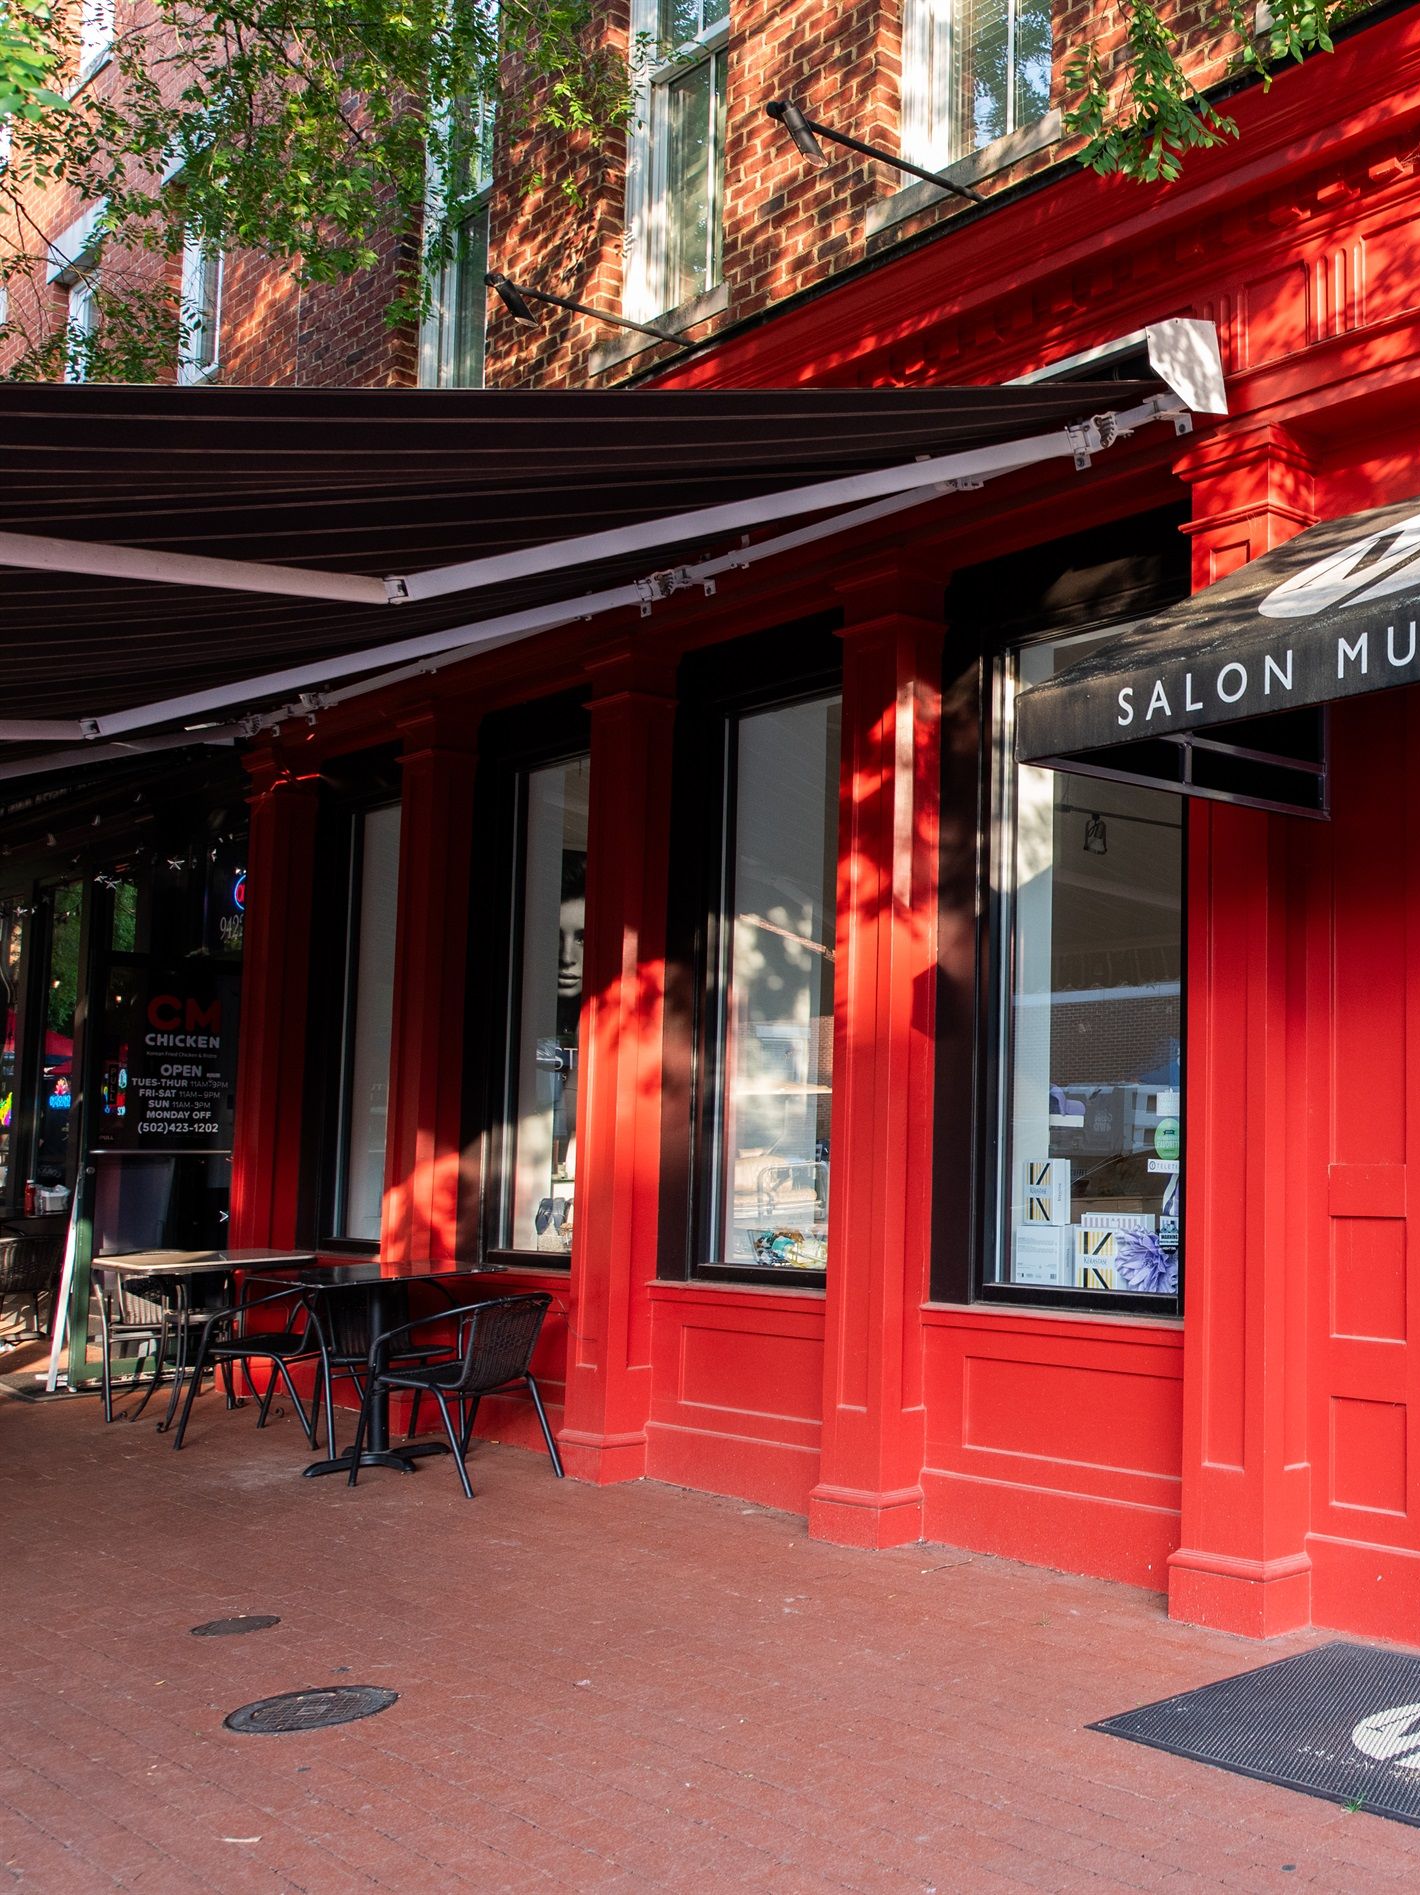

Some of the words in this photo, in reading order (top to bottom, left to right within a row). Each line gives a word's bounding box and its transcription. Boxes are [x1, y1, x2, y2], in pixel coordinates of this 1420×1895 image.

[1117, 649, 1293, 727] SALON
[147, 993, 221, 1032] CM
[145, 1032, 220, 1049] CHICKEN
[160, 1064, 203, 1077] OPEN
[131, 1077, 189, 1088] TUES-THUR
[139, 1088, 177, 1098] FRI-SAT
[148, 1100, 170, 1108] SUN
[146, 1110, 191, 1119] MONDAY
[192, 1111, 212, 1119] OFF
[138, 1121, 219, 1135] (502)423-1202
